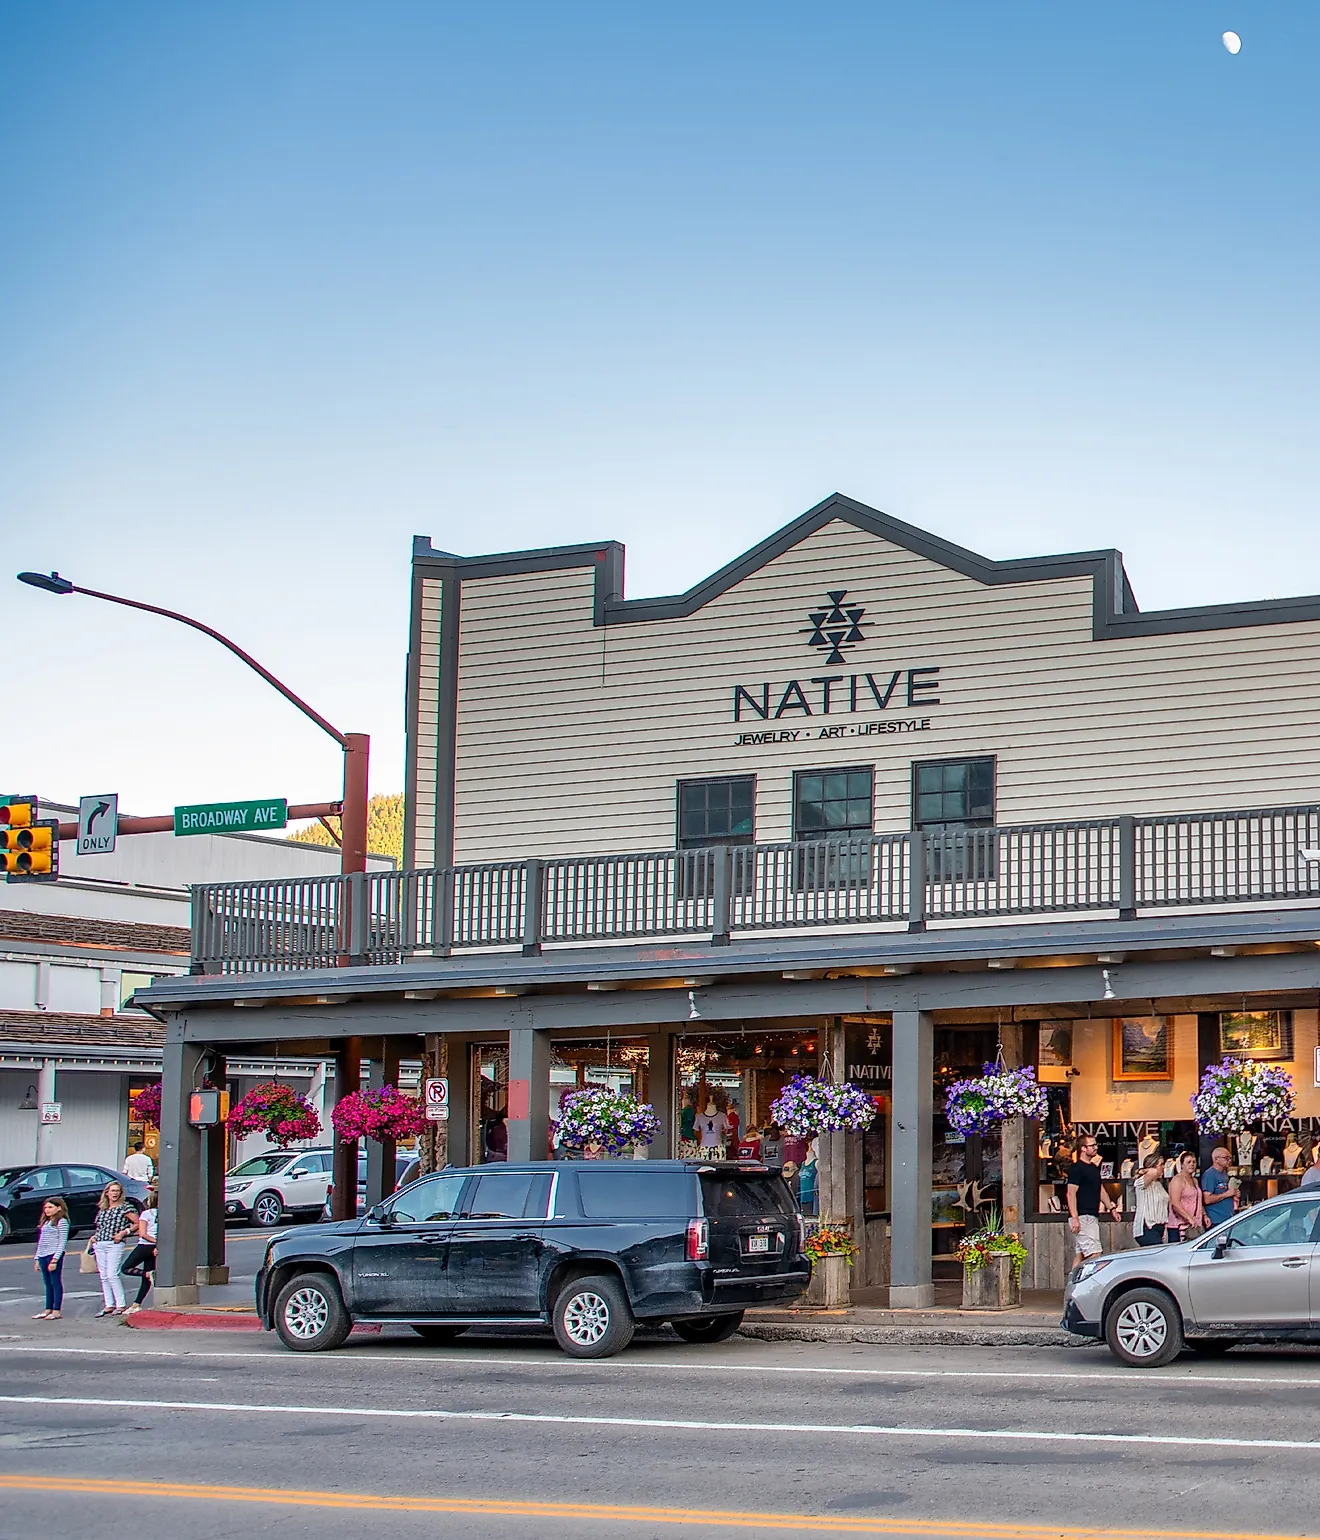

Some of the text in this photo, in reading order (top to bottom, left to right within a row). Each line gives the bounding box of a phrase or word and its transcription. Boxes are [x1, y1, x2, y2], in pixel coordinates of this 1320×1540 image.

[734, 667, 940, 722] NATIVE
[734, 719, 931, 746] JEWELRY ART LIFESTYLE
[181, 806, 278, 829] BROADWAY AVE
[83, 837, 110, 850] ONLY
[1077, 1121, 1160, 1138] NATIVE
